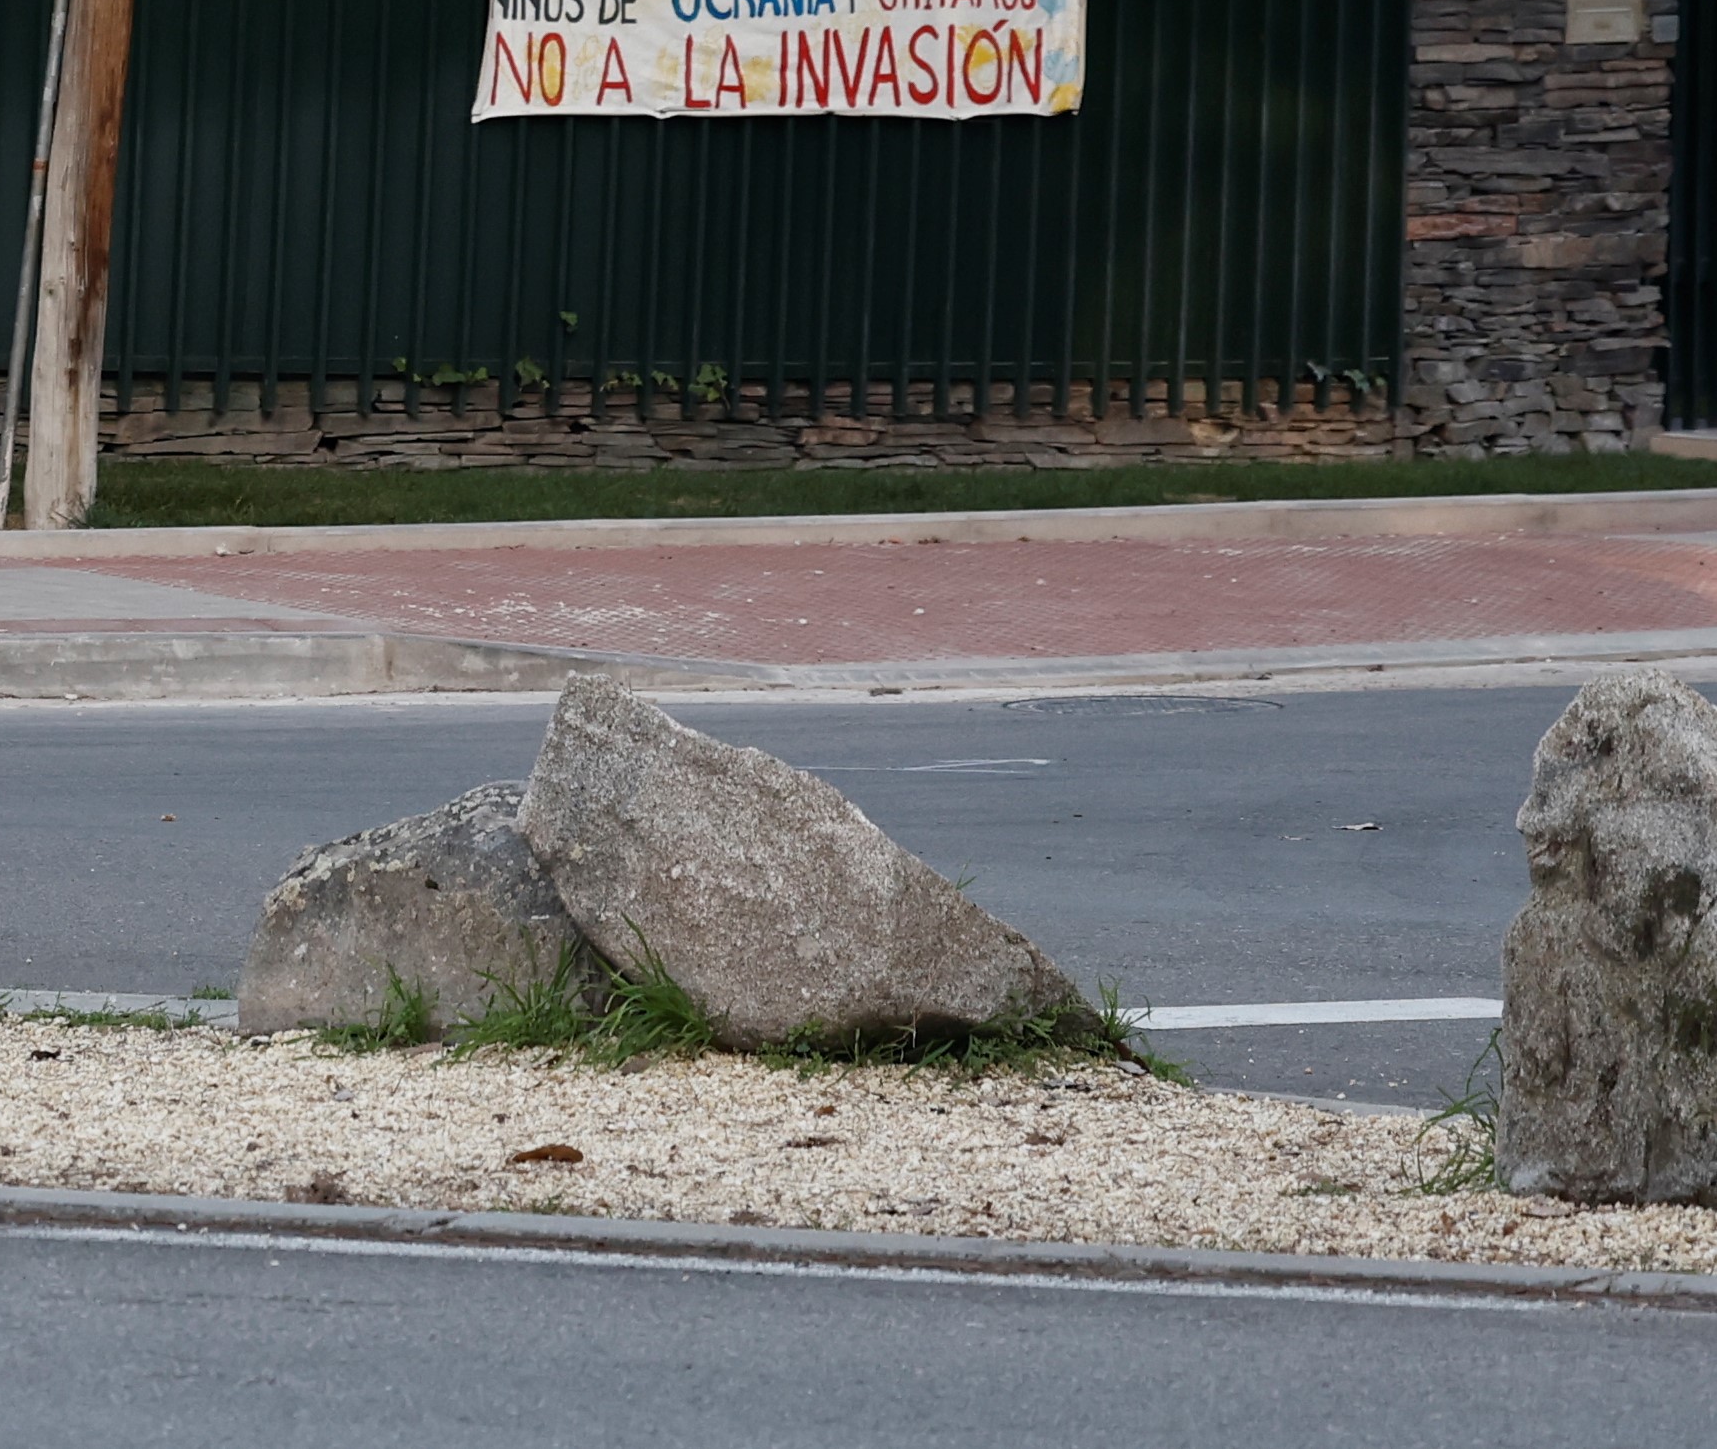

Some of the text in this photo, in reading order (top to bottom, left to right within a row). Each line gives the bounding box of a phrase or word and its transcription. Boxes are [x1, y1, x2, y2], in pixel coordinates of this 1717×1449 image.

[490, 19, 1044, 109] NO A LA INVASIÓN
